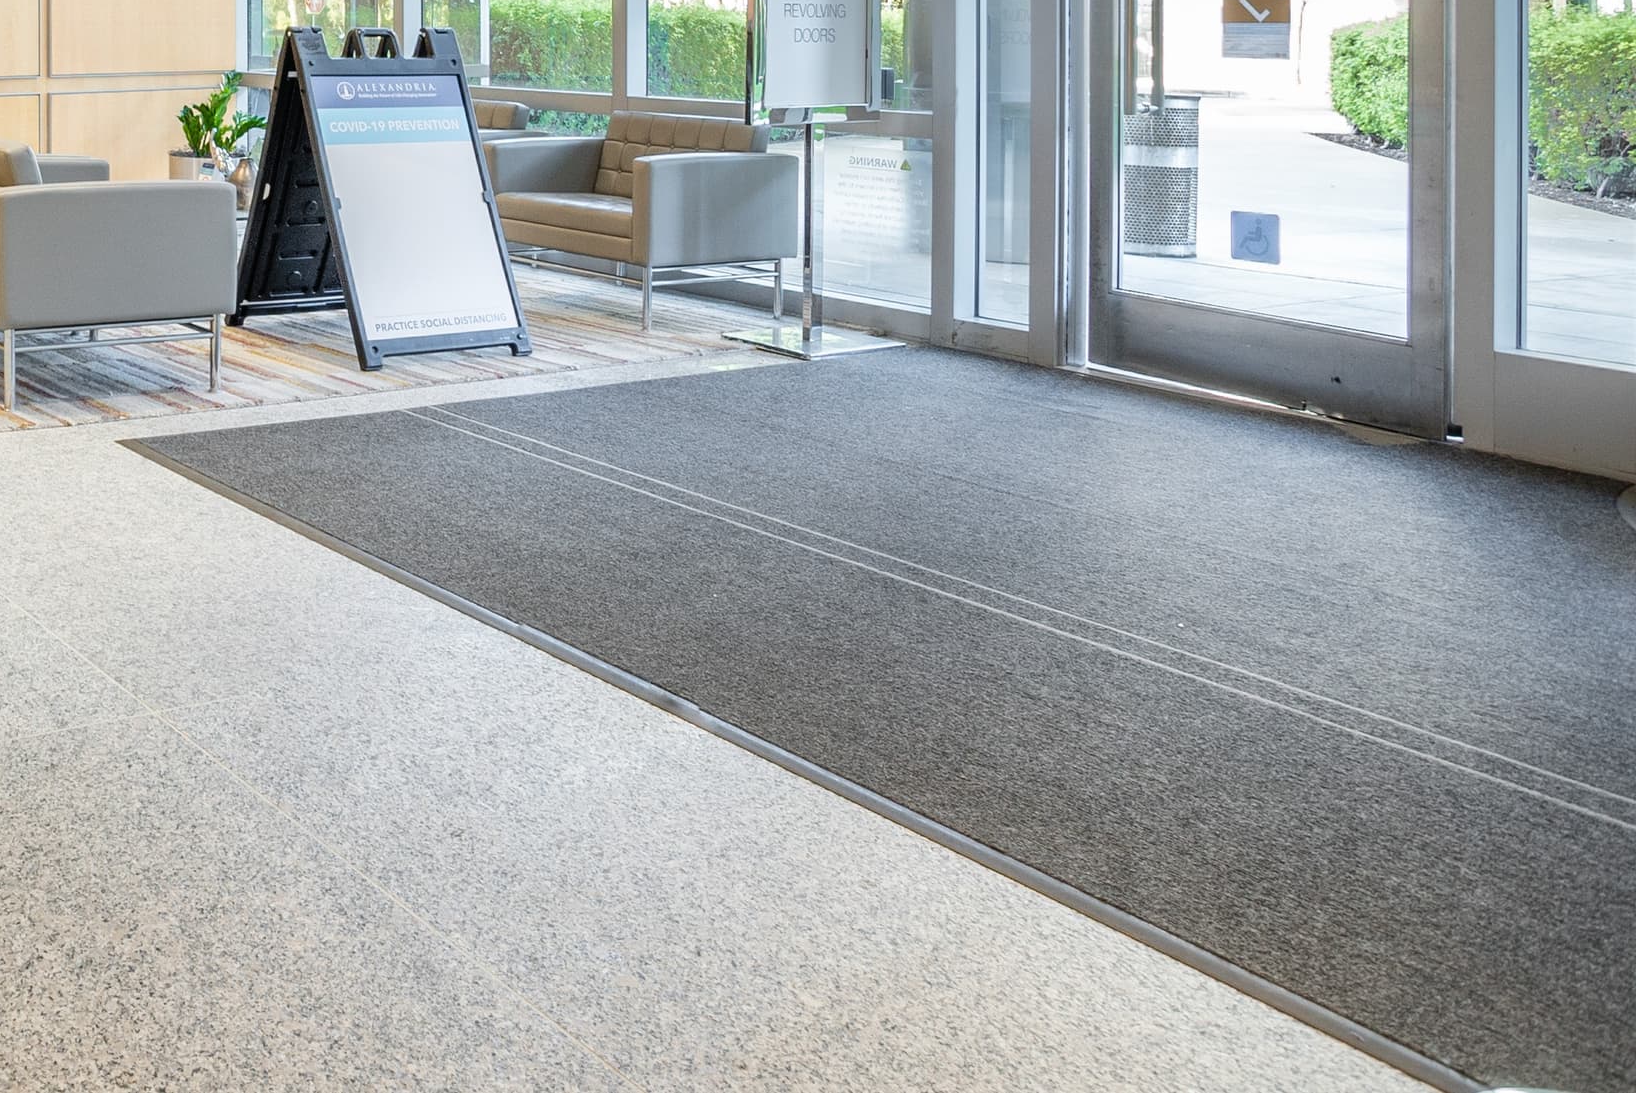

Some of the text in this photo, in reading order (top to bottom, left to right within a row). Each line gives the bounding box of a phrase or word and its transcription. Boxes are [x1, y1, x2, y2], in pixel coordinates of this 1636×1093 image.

[783, 3, 846, 19] REVOLVING
[794, 27, 836, 43] DOORS
[357, 83, 437, 93] ALEXANDRIA
[330, 119, 461, 133] COVID-19 PREVENTION
[374, 312, 507, 333] PRACTICE SOCIAL DISTANCING
